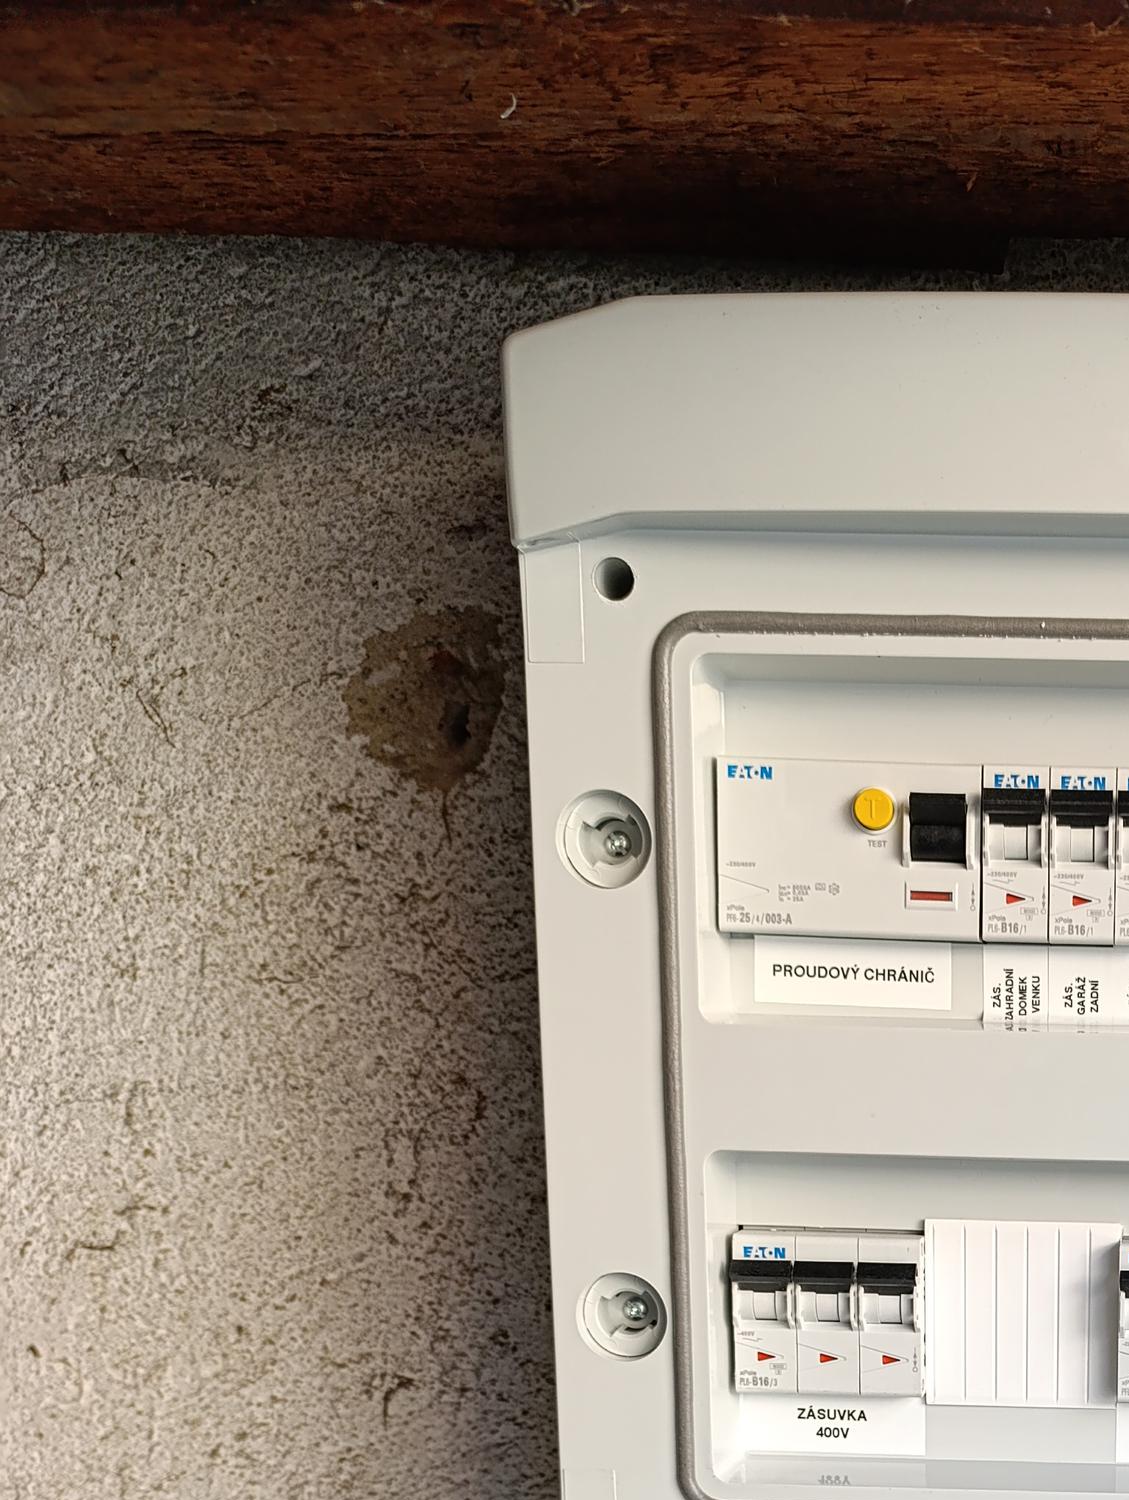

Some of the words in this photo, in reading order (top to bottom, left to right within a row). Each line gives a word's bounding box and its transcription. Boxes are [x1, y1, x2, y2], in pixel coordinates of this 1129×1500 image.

[727, 764, 773, 780] EATON
[994, 774, 1040, 788] EATON
[1060, 776, 1106, 790] EATON
[868, 839, 887, 848] TEST
[772, 963, 860, 980] PROUDOVÝ
[864, 966, 935, 983] CHRÁNIČ
[990, 983, 1001, 1008] ZÁS.
[1003, 968, 1014, 1020] ZAHRADNÍ
[1018, 976, 1027, 1016] DOMEK
[1032, 975, 1040, 1013] VENKU
[1063, 983, 1073, 1008] ZÁS.
[1076, 977, 1086, 1015] GARÁŽ
[1089, 980, 1099, 1013] ZADNÍ
[743, 1246, 786, 1259] EATON
[797, 1406, 867, 1421] ZÁSUVKA
[816, 1427, 849, 1439] 400V
